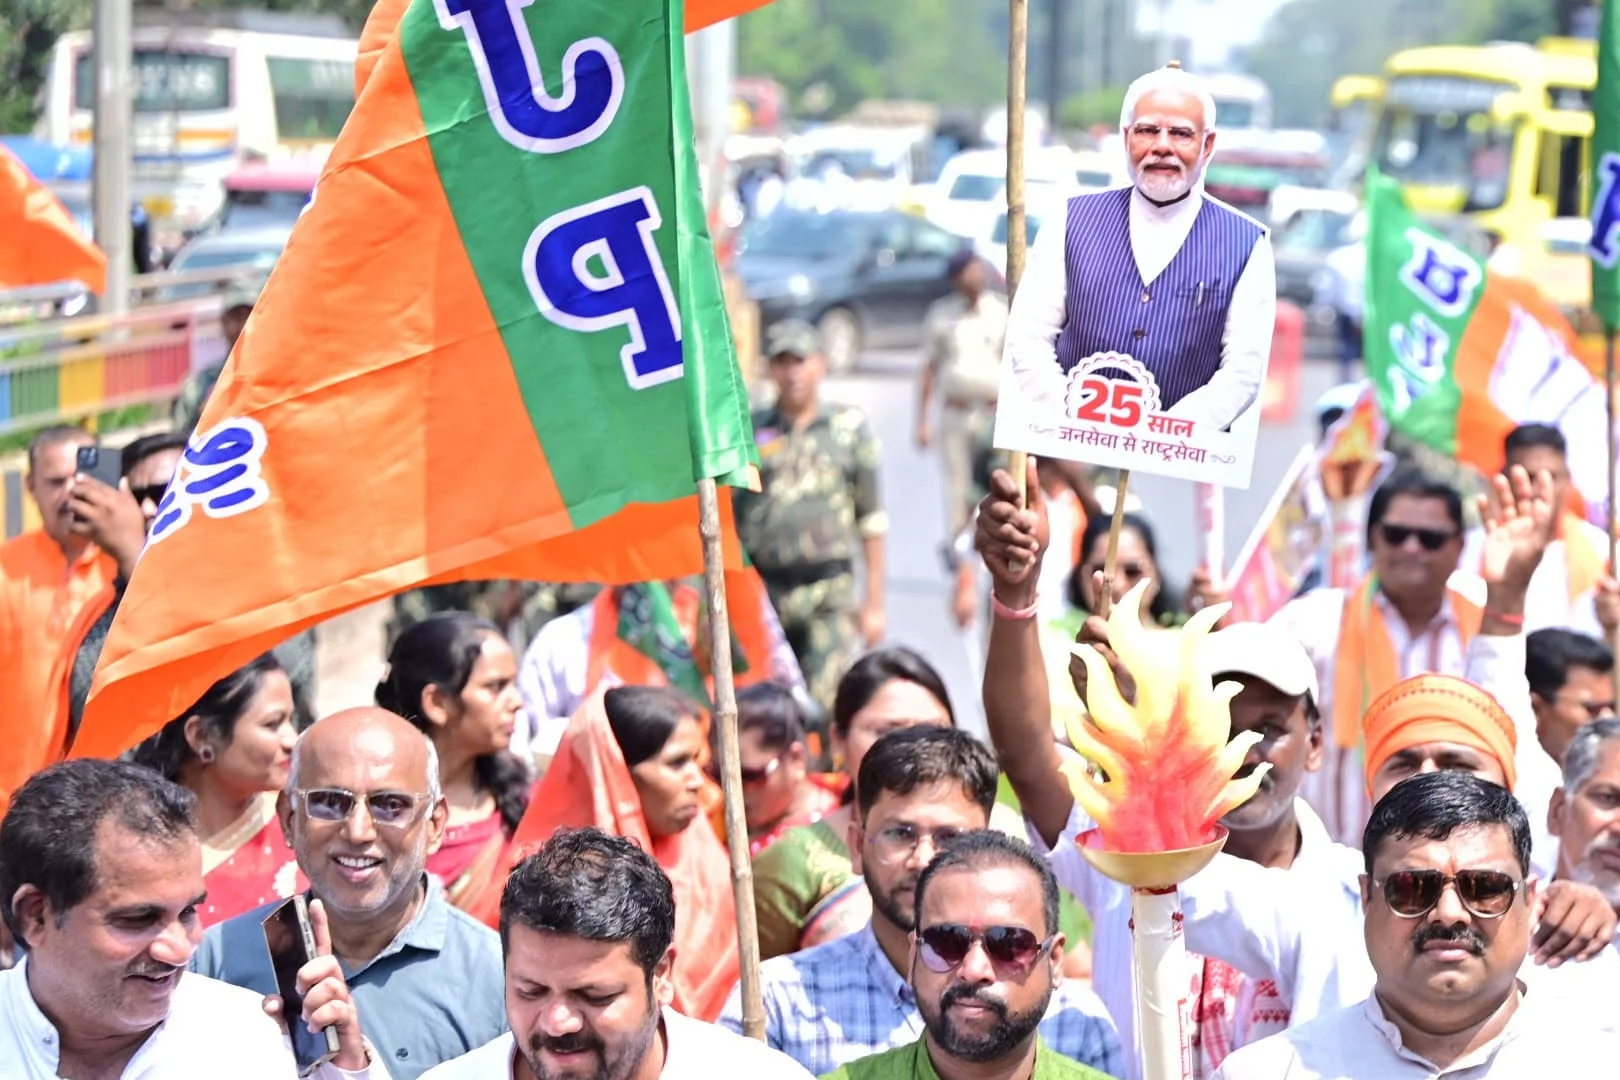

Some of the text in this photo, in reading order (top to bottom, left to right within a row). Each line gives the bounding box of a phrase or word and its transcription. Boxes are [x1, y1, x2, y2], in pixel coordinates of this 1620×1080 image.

[1077, 378, 1195, 438] 25 साल
[1058, 425, 1117, 449] जनसेवा
[1122, 431, 1136, 453] से
